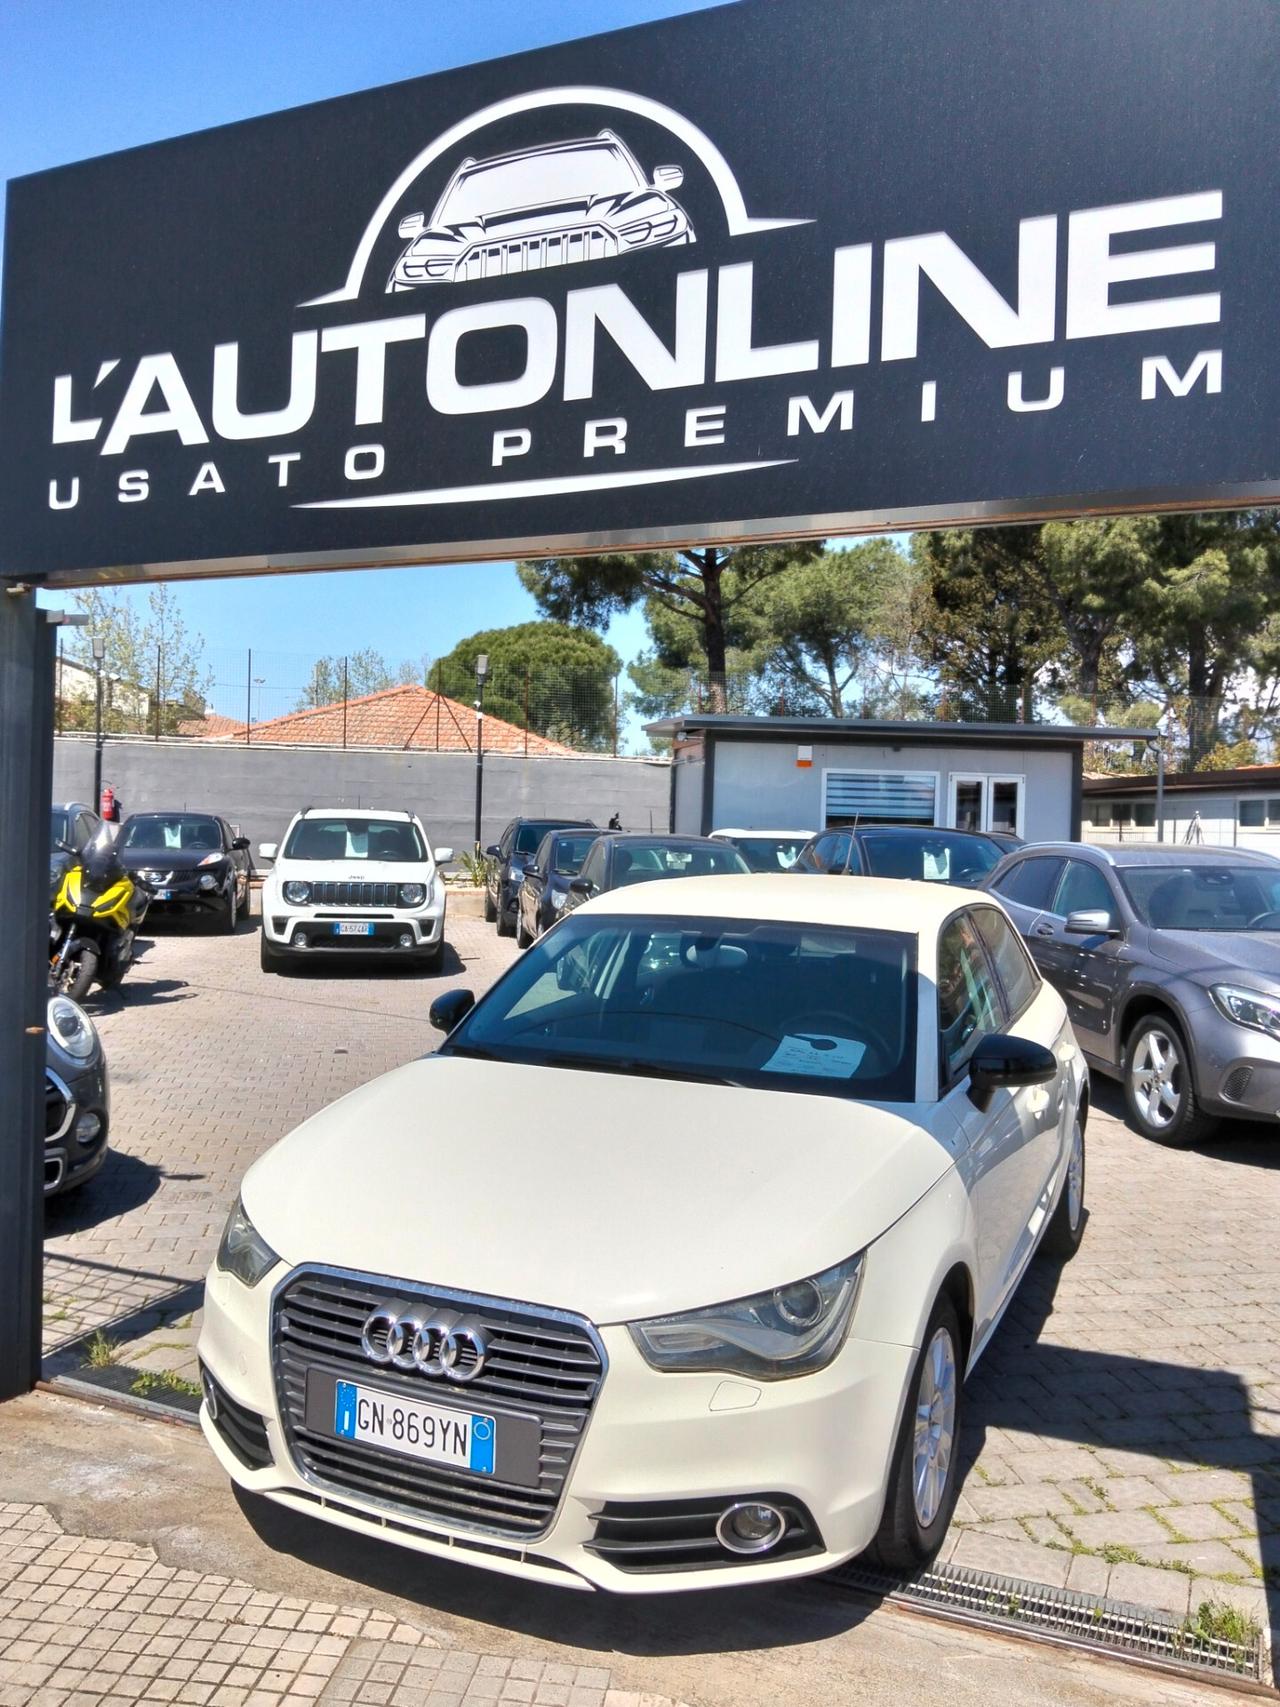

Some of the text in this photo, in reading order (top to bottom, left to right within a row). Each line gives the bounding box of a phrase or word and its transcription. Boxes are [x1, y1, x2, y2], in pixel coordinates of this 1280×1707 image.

[51, 190, 1224, 455] L'AUTONLINE
[48, 349, 1224, 510] USATO PREMIUM
[357, 1398, 468, 1457] GN 869YN
